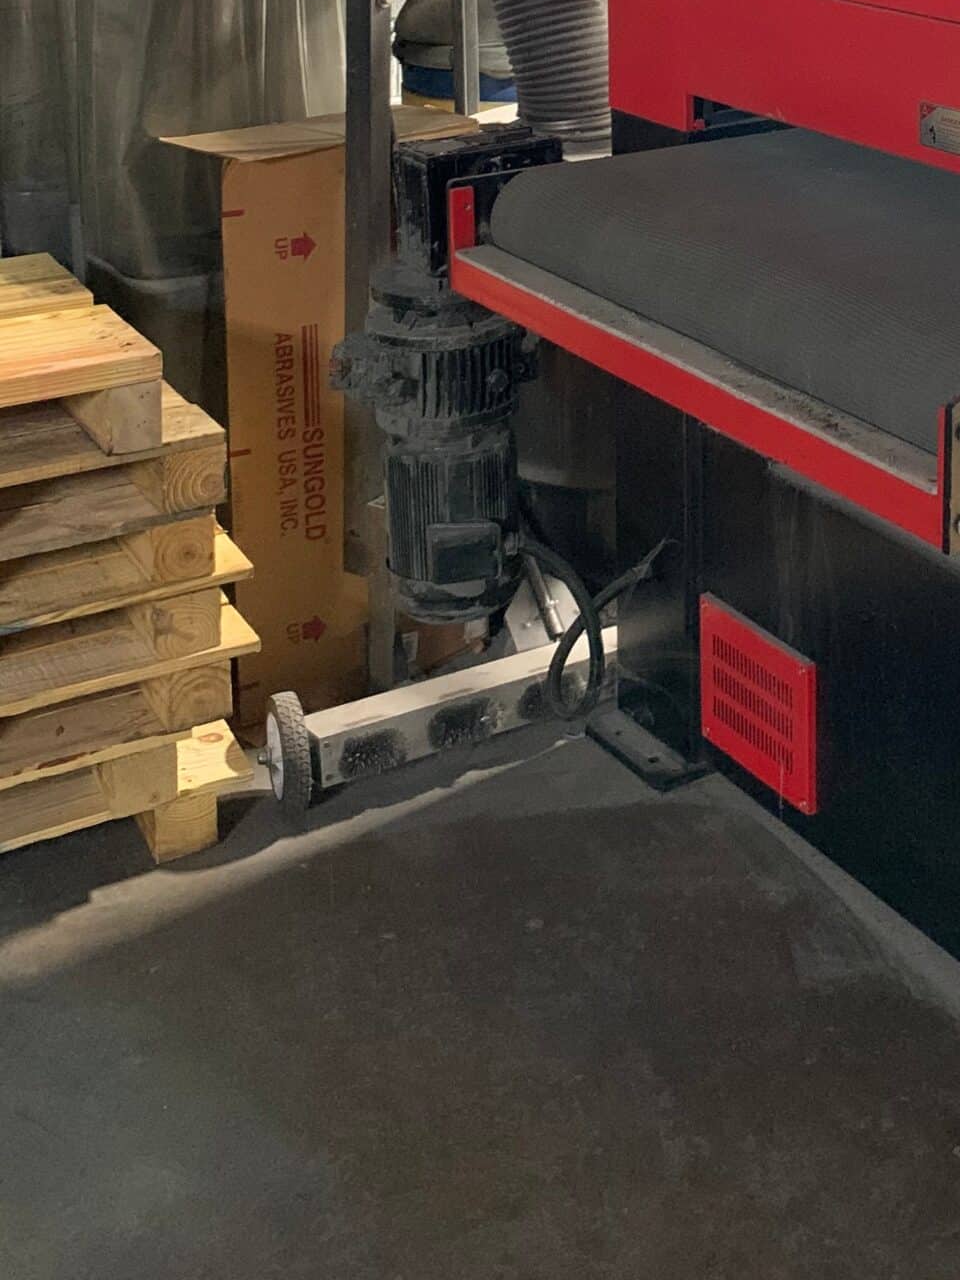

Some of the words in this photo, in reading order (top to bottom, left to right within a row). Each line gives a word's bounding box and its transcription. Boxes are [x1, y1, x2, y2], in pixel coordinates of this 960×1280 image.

[274, 236, 288, 260] UP
[274, 332, 296, 441] ABRASIVES
[302, 427, 327, 541] SUNGOLD
[280, 499, 298, 537] INC.
[286, 622, 299, 644] UP
